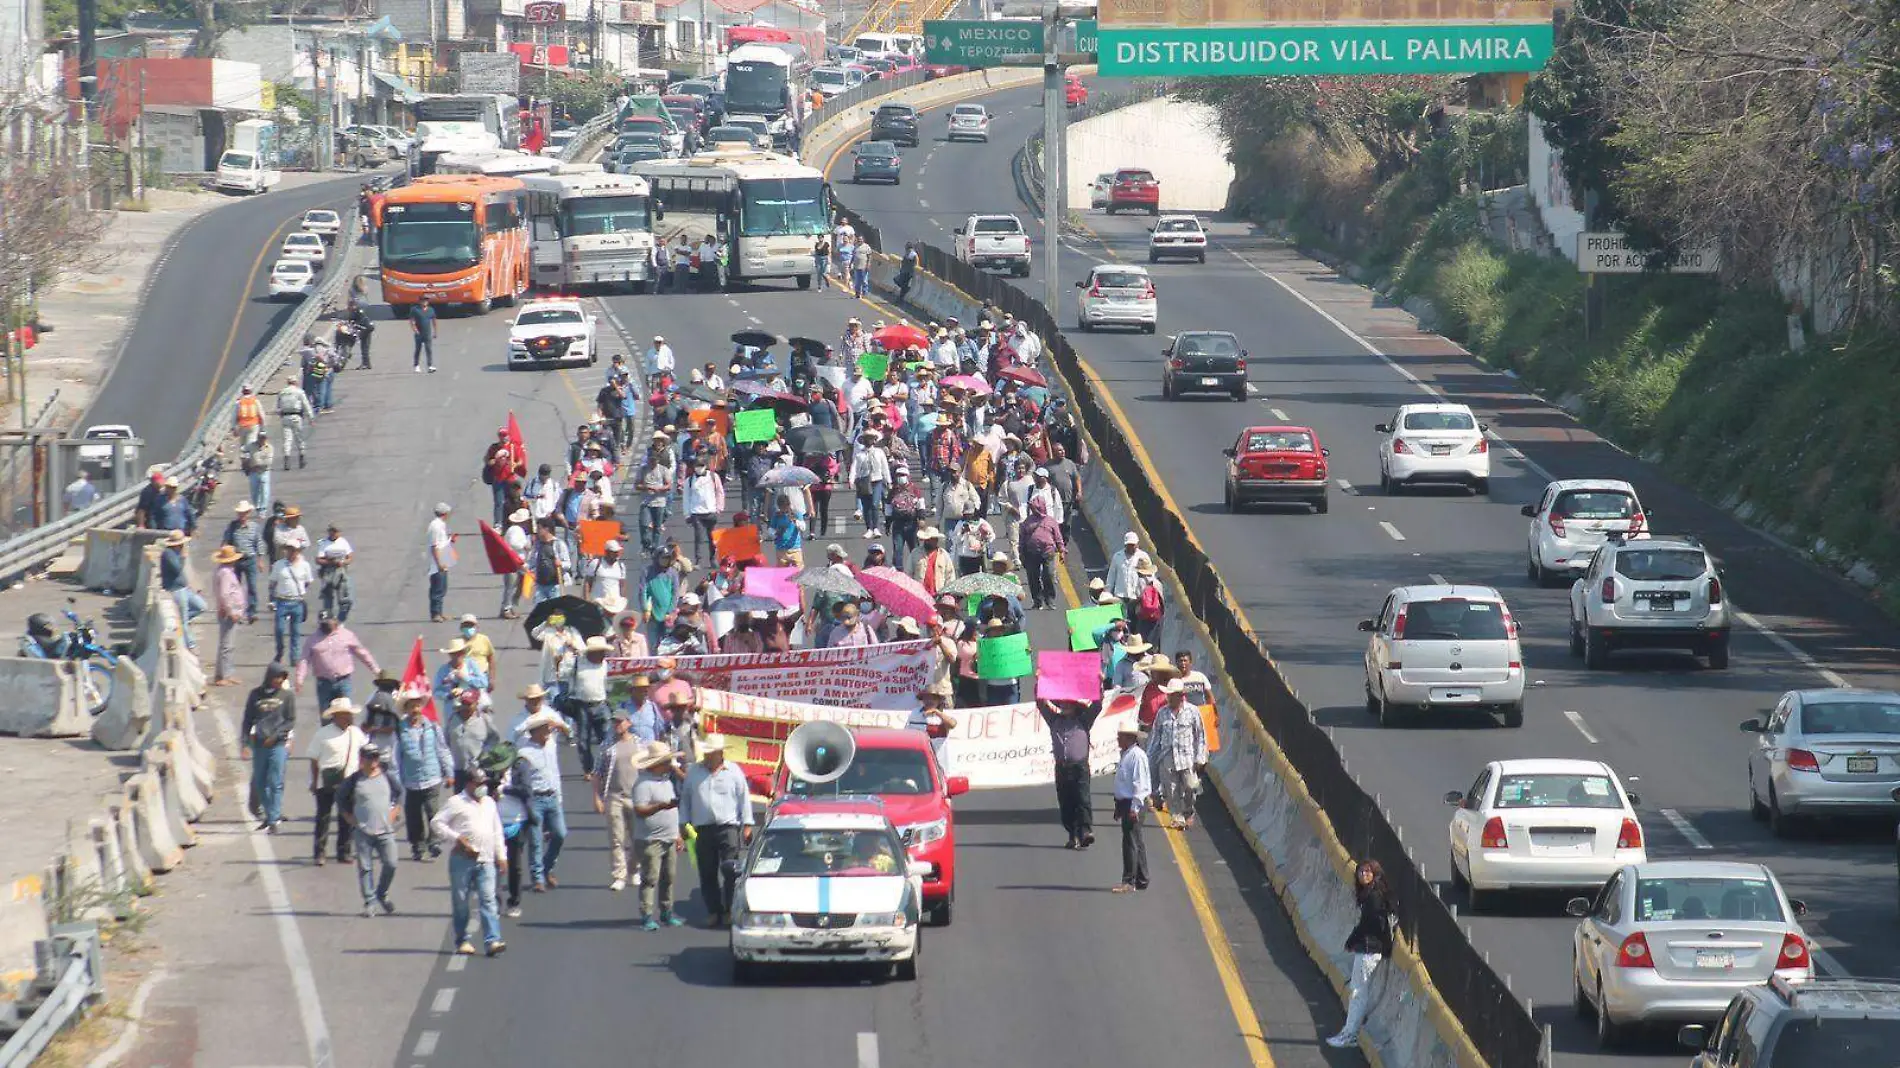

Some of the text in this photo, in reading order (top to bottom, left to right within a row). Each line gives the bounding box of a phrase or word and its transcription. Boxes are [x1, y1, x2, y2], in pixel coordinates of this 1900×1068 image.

[958, 28, 1031, 40] MEXICO
[1116, 37, 1534, 64] DISTRIBUIDOR VIAL PALMIRA
[1596, 254, 1621, 268] POR
[774, 680, 801, 688] PASO
[776, 688, 817, 696] TRAMO
[812, 698, 839, 706] COMO
[967, 711, 1001, 739] DE
[956, 744, 1046, 765] rezagados
